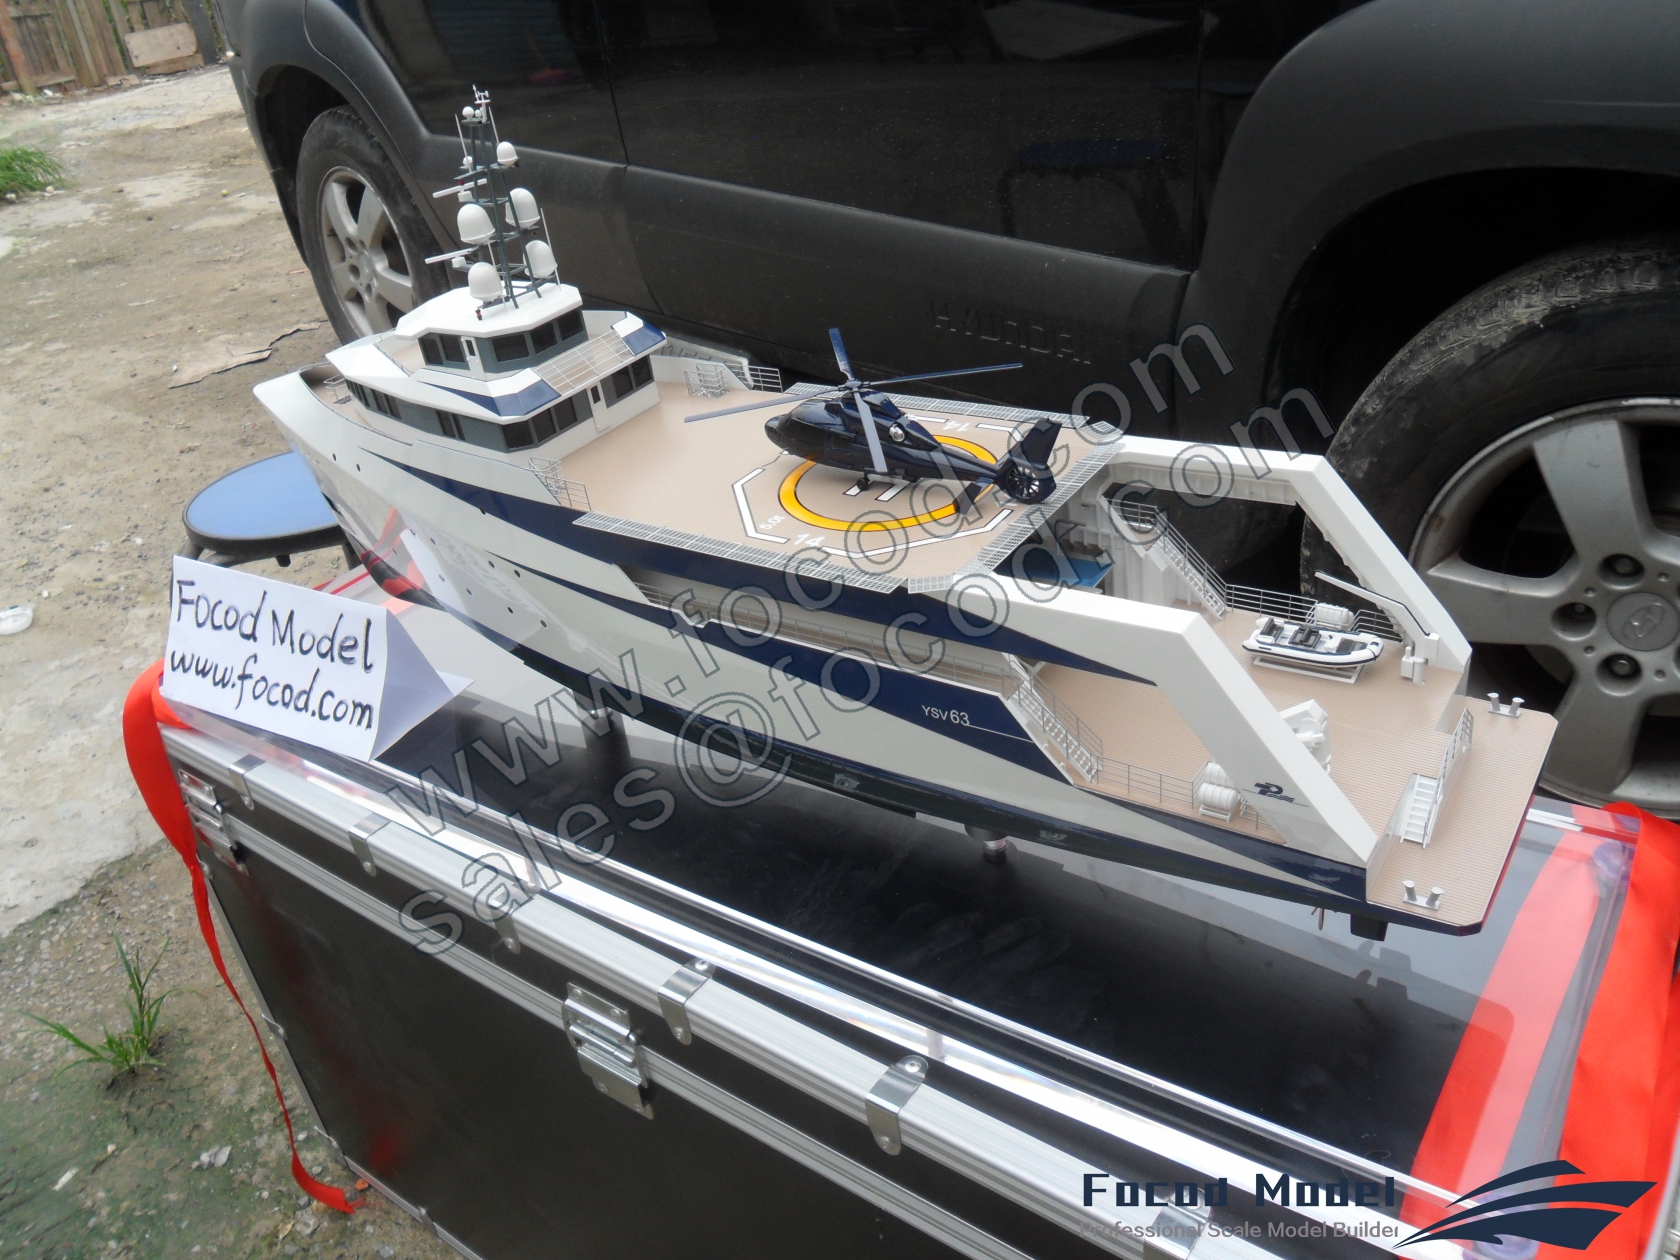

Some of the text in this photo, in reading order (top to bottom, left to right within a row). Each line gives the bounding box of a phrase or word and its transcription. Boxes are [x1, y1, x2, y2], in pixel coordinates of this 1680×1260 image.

[793, 533, 826, 548] 14
[176, 580, 374, 674] Focod Model
[170, 649, 374, 731] www.focod.com
